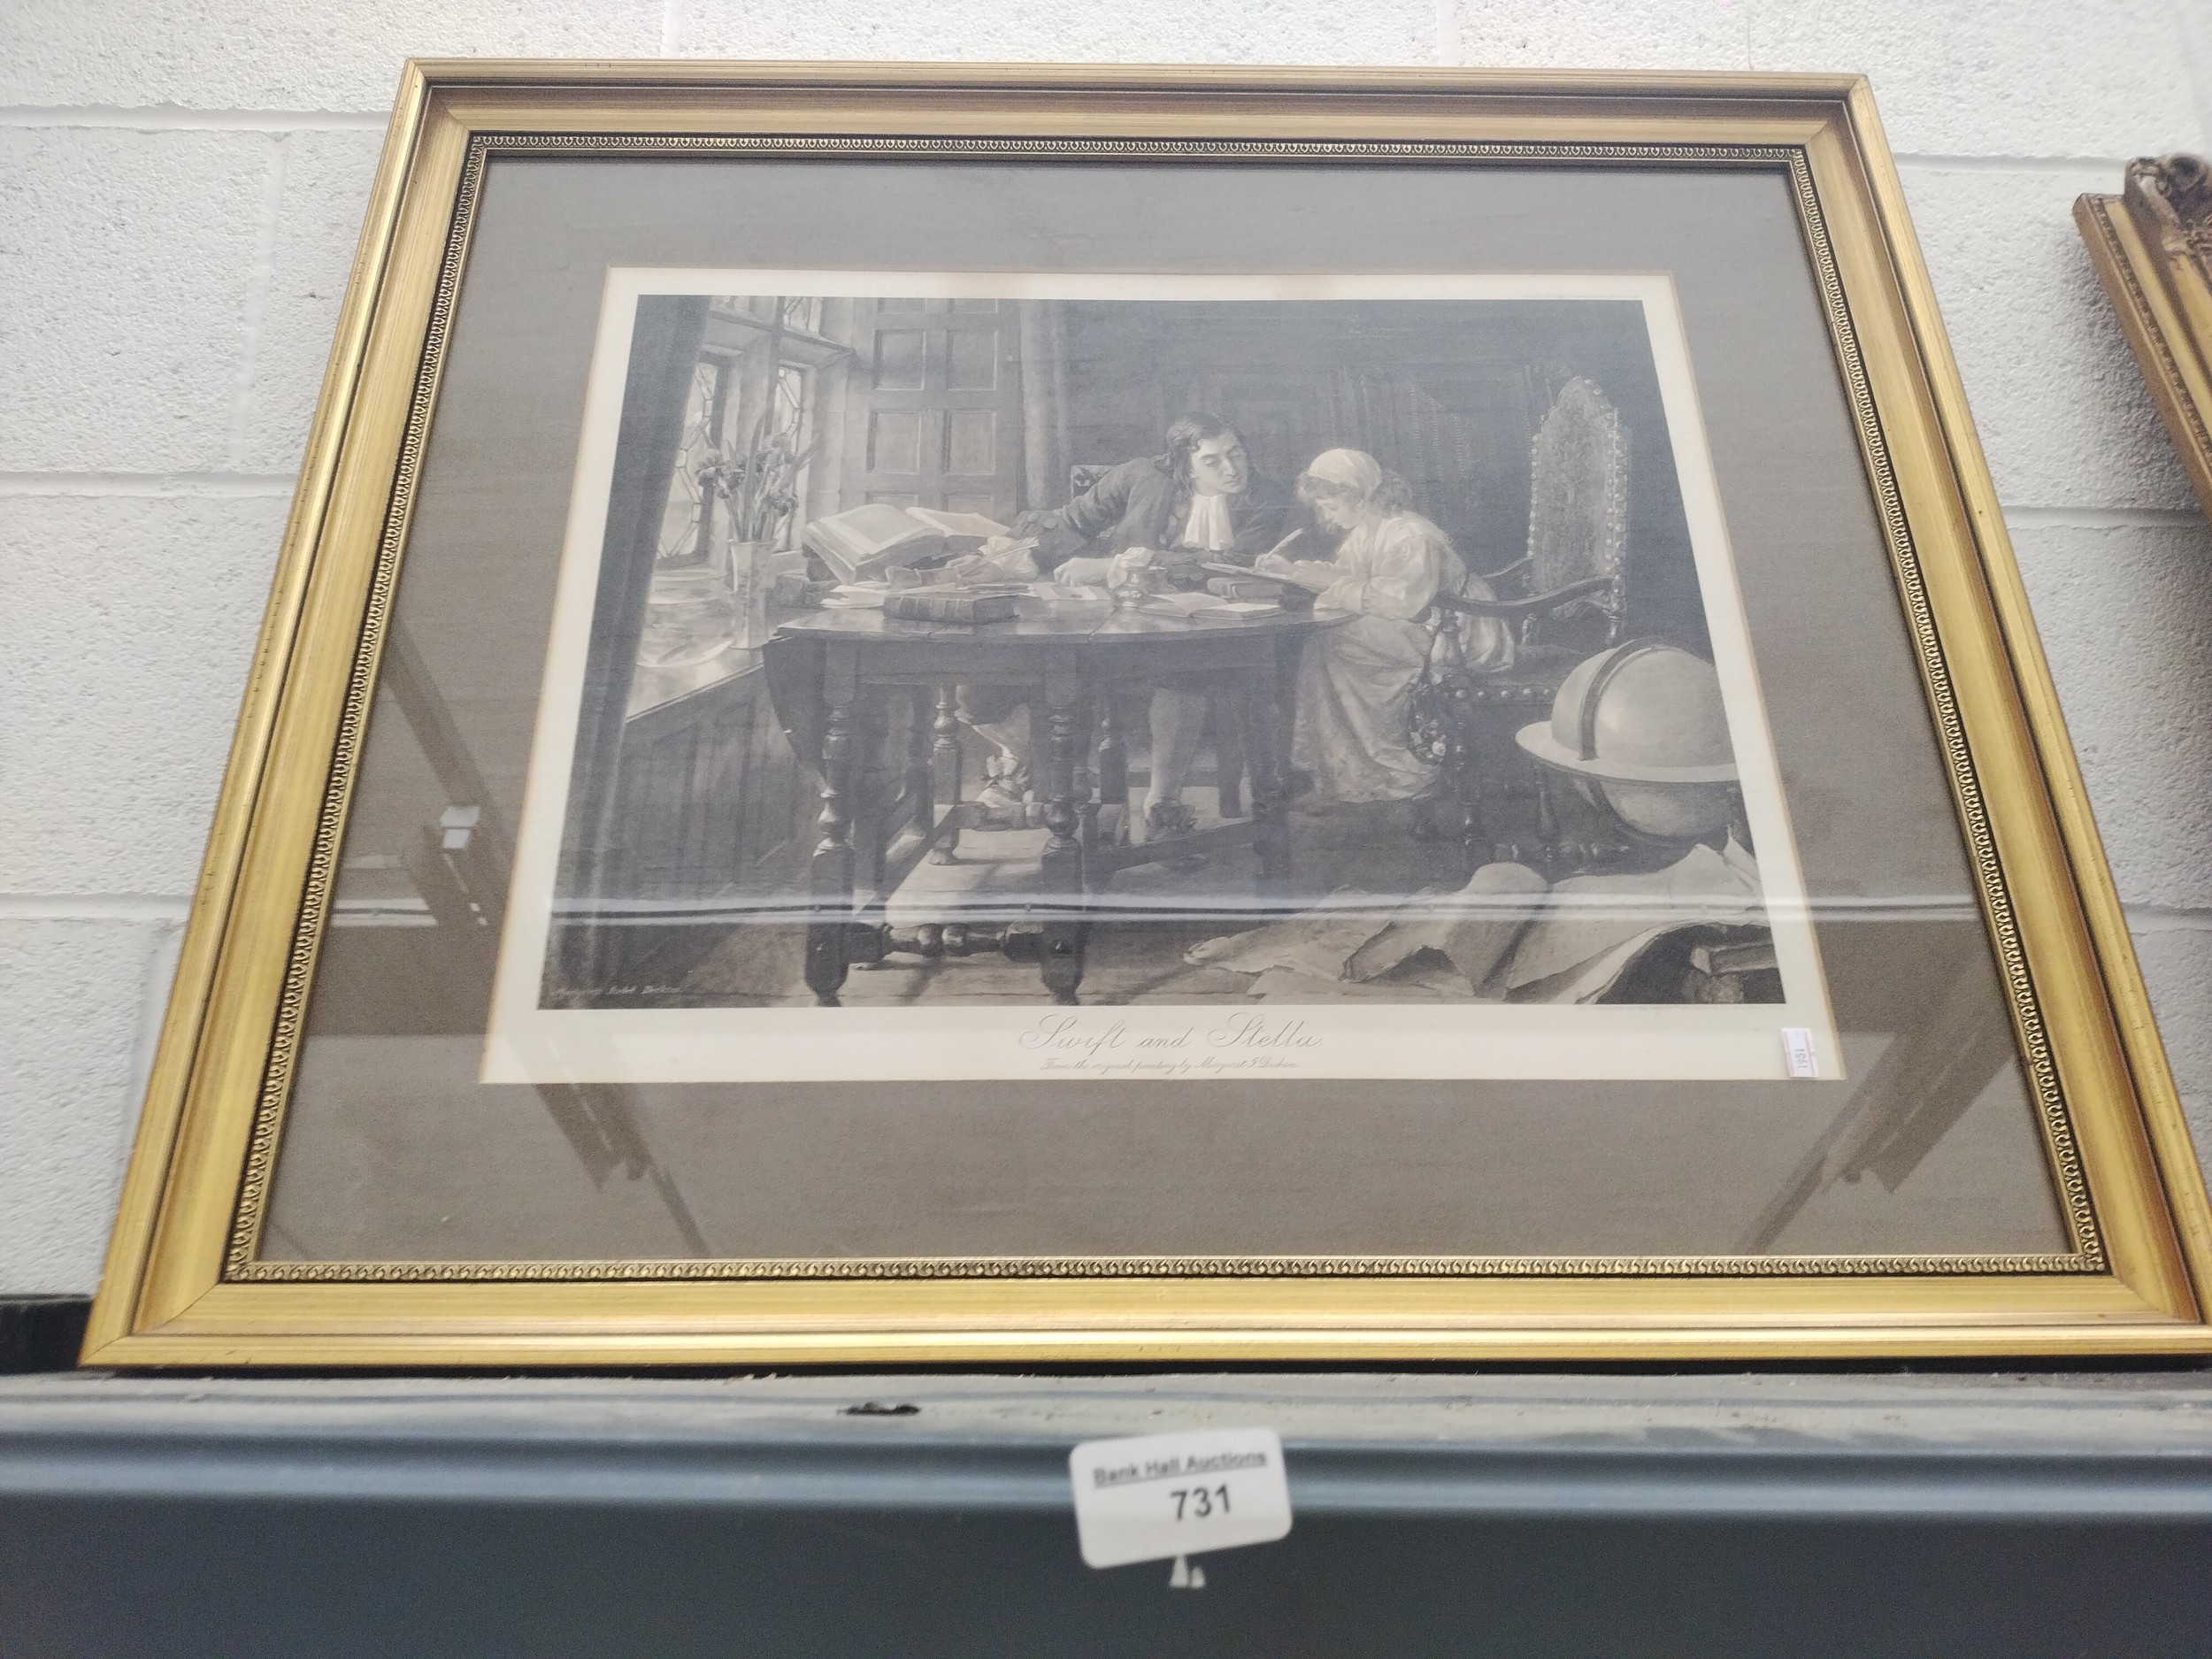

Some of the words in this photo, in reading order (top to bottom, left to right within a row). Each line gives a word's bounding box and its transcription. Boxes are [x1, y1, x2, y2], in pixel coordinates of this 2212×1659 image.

[1018, 1013, 1127, 1056] Swift
[1137, 1026, 1194, 1048] and
[1093, 1464, 1139, 1486] Bank
[1145, 1457, 1180, 1479] Hall
[1185, 1451, 1268, 1473] Auctions
[1170, 1483, 1231, 1522] 731
